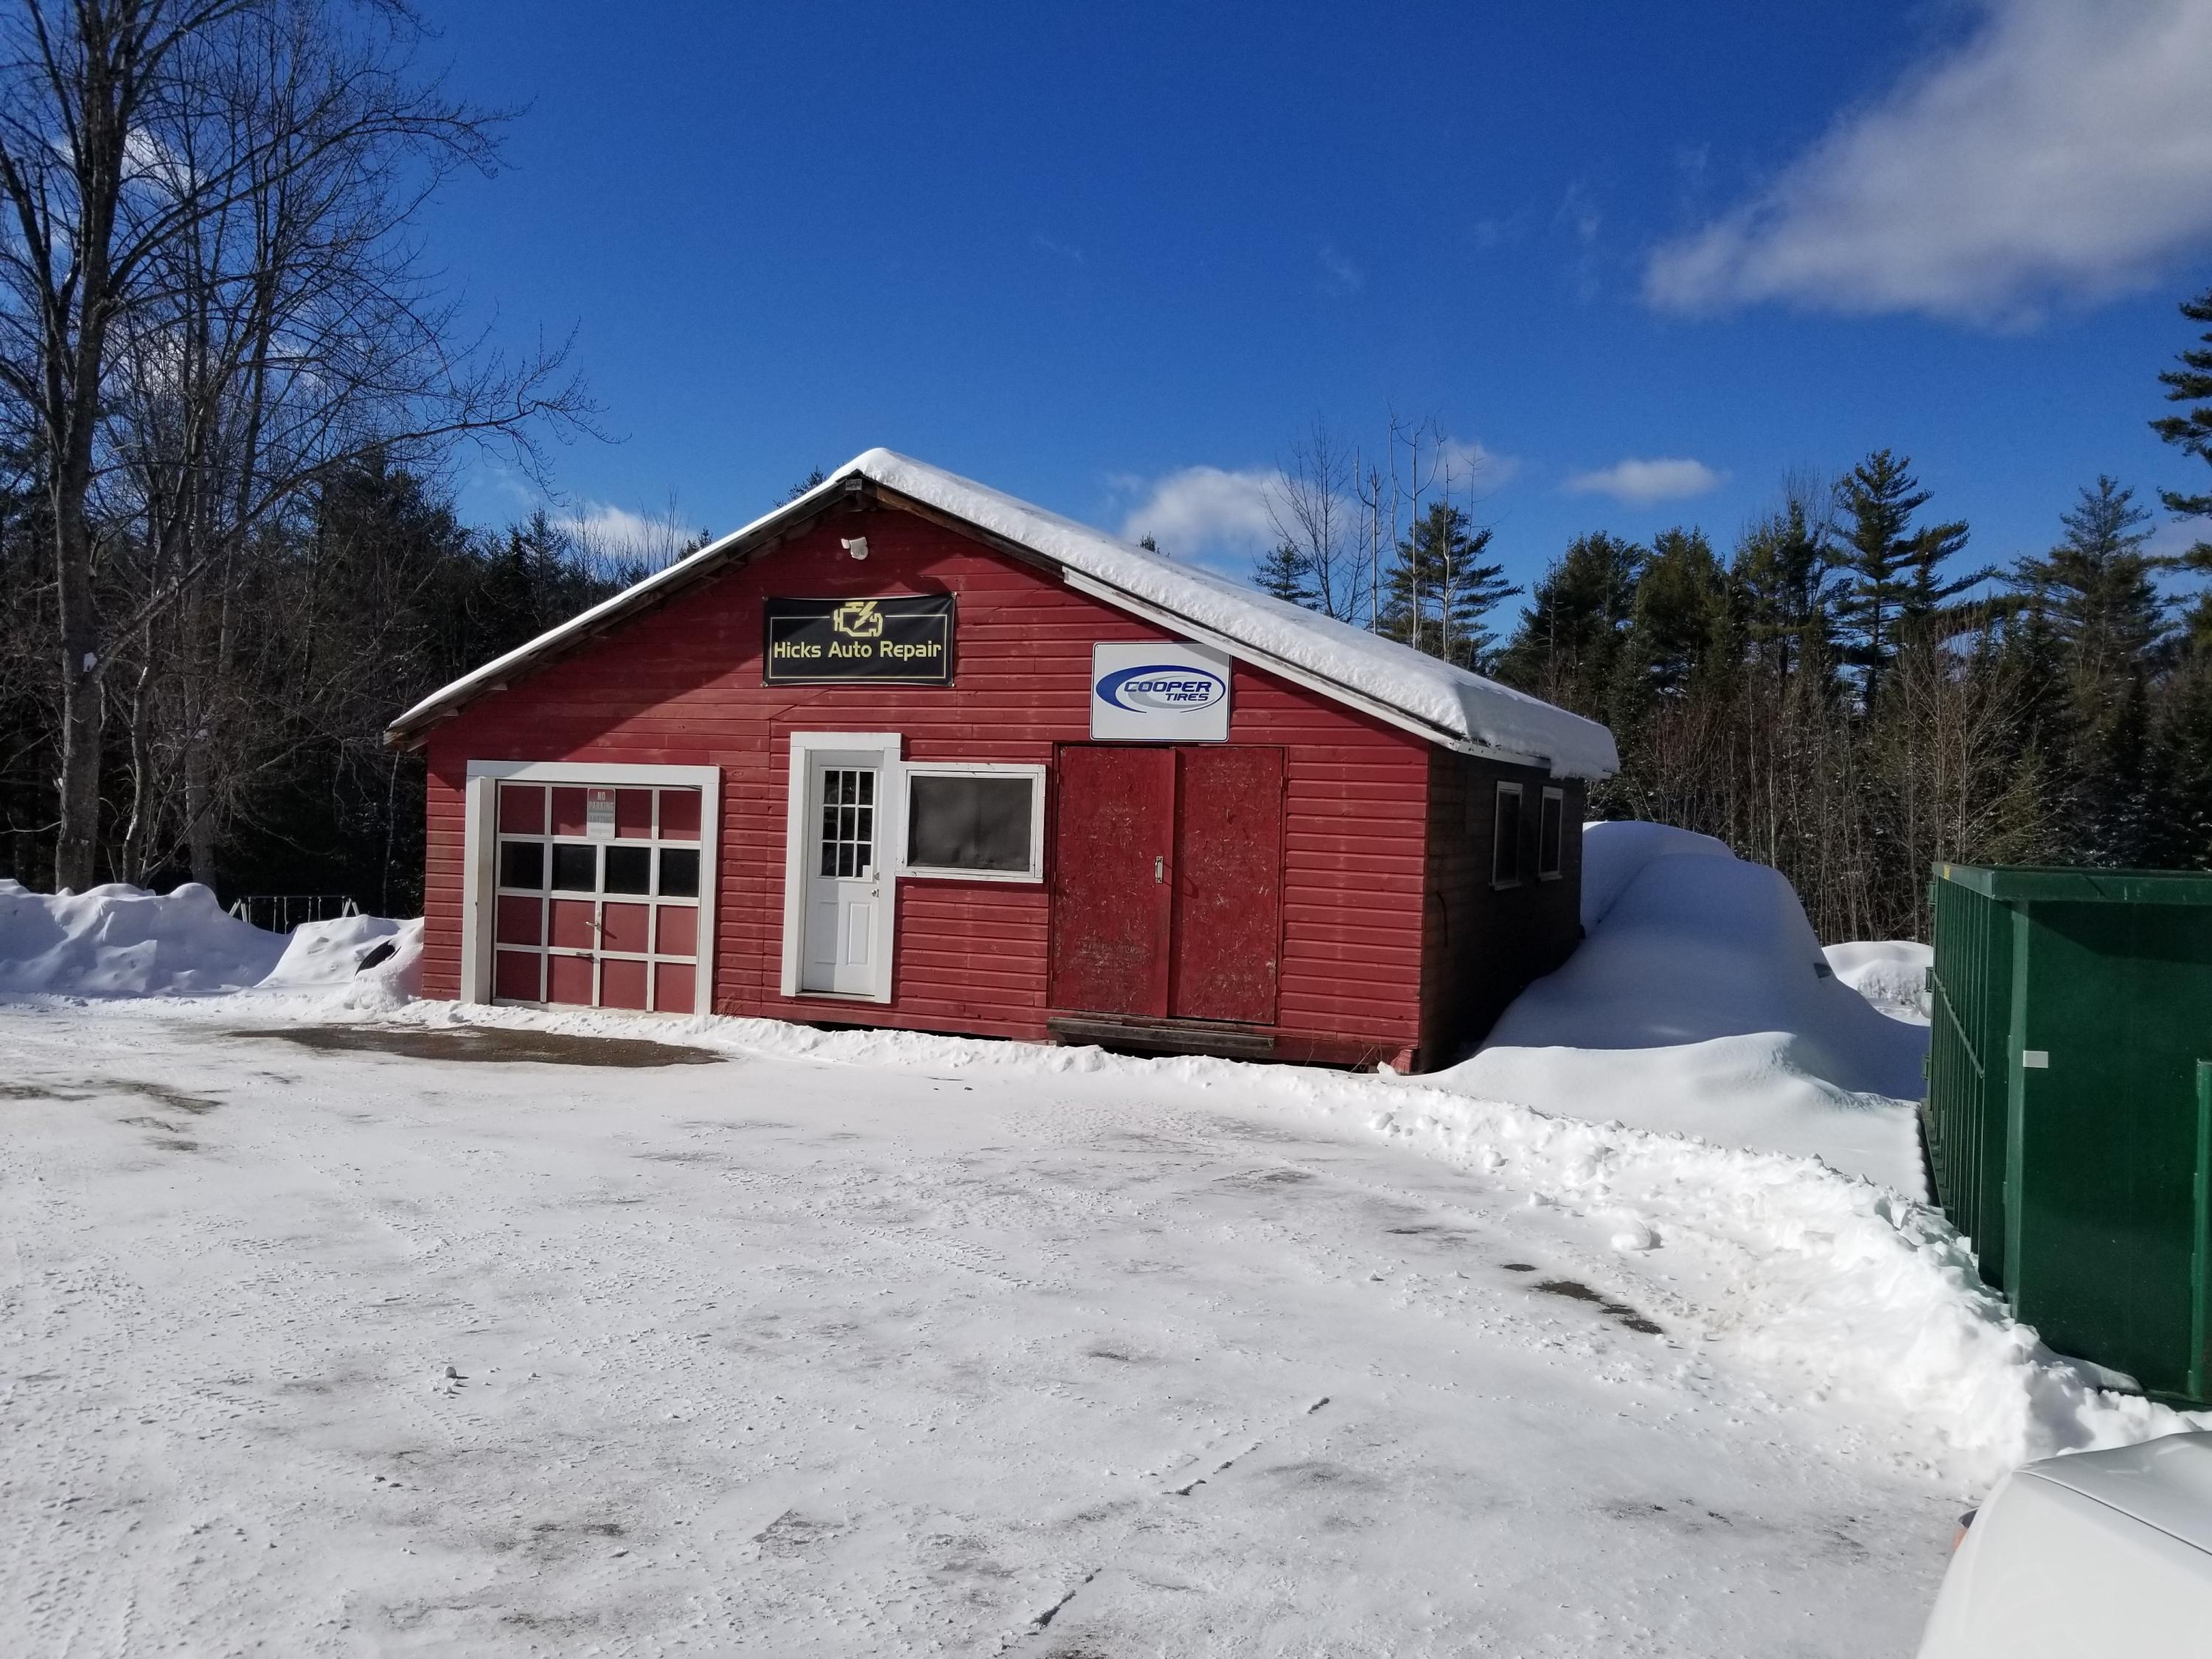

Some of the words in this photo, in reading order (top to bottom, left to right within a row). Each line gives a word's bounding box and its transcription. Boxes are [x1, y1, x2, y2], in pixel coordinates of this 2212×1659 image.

[774, 641, 821, 658] Hicks
[828, 641, 872, 658] Auto
[880, 641, 941, 661] Repair
[1124, 681, 1211, 692] COOPER
[1165, 693, 1208, 701] TIRES
[597, 791, 605, 801] NO
